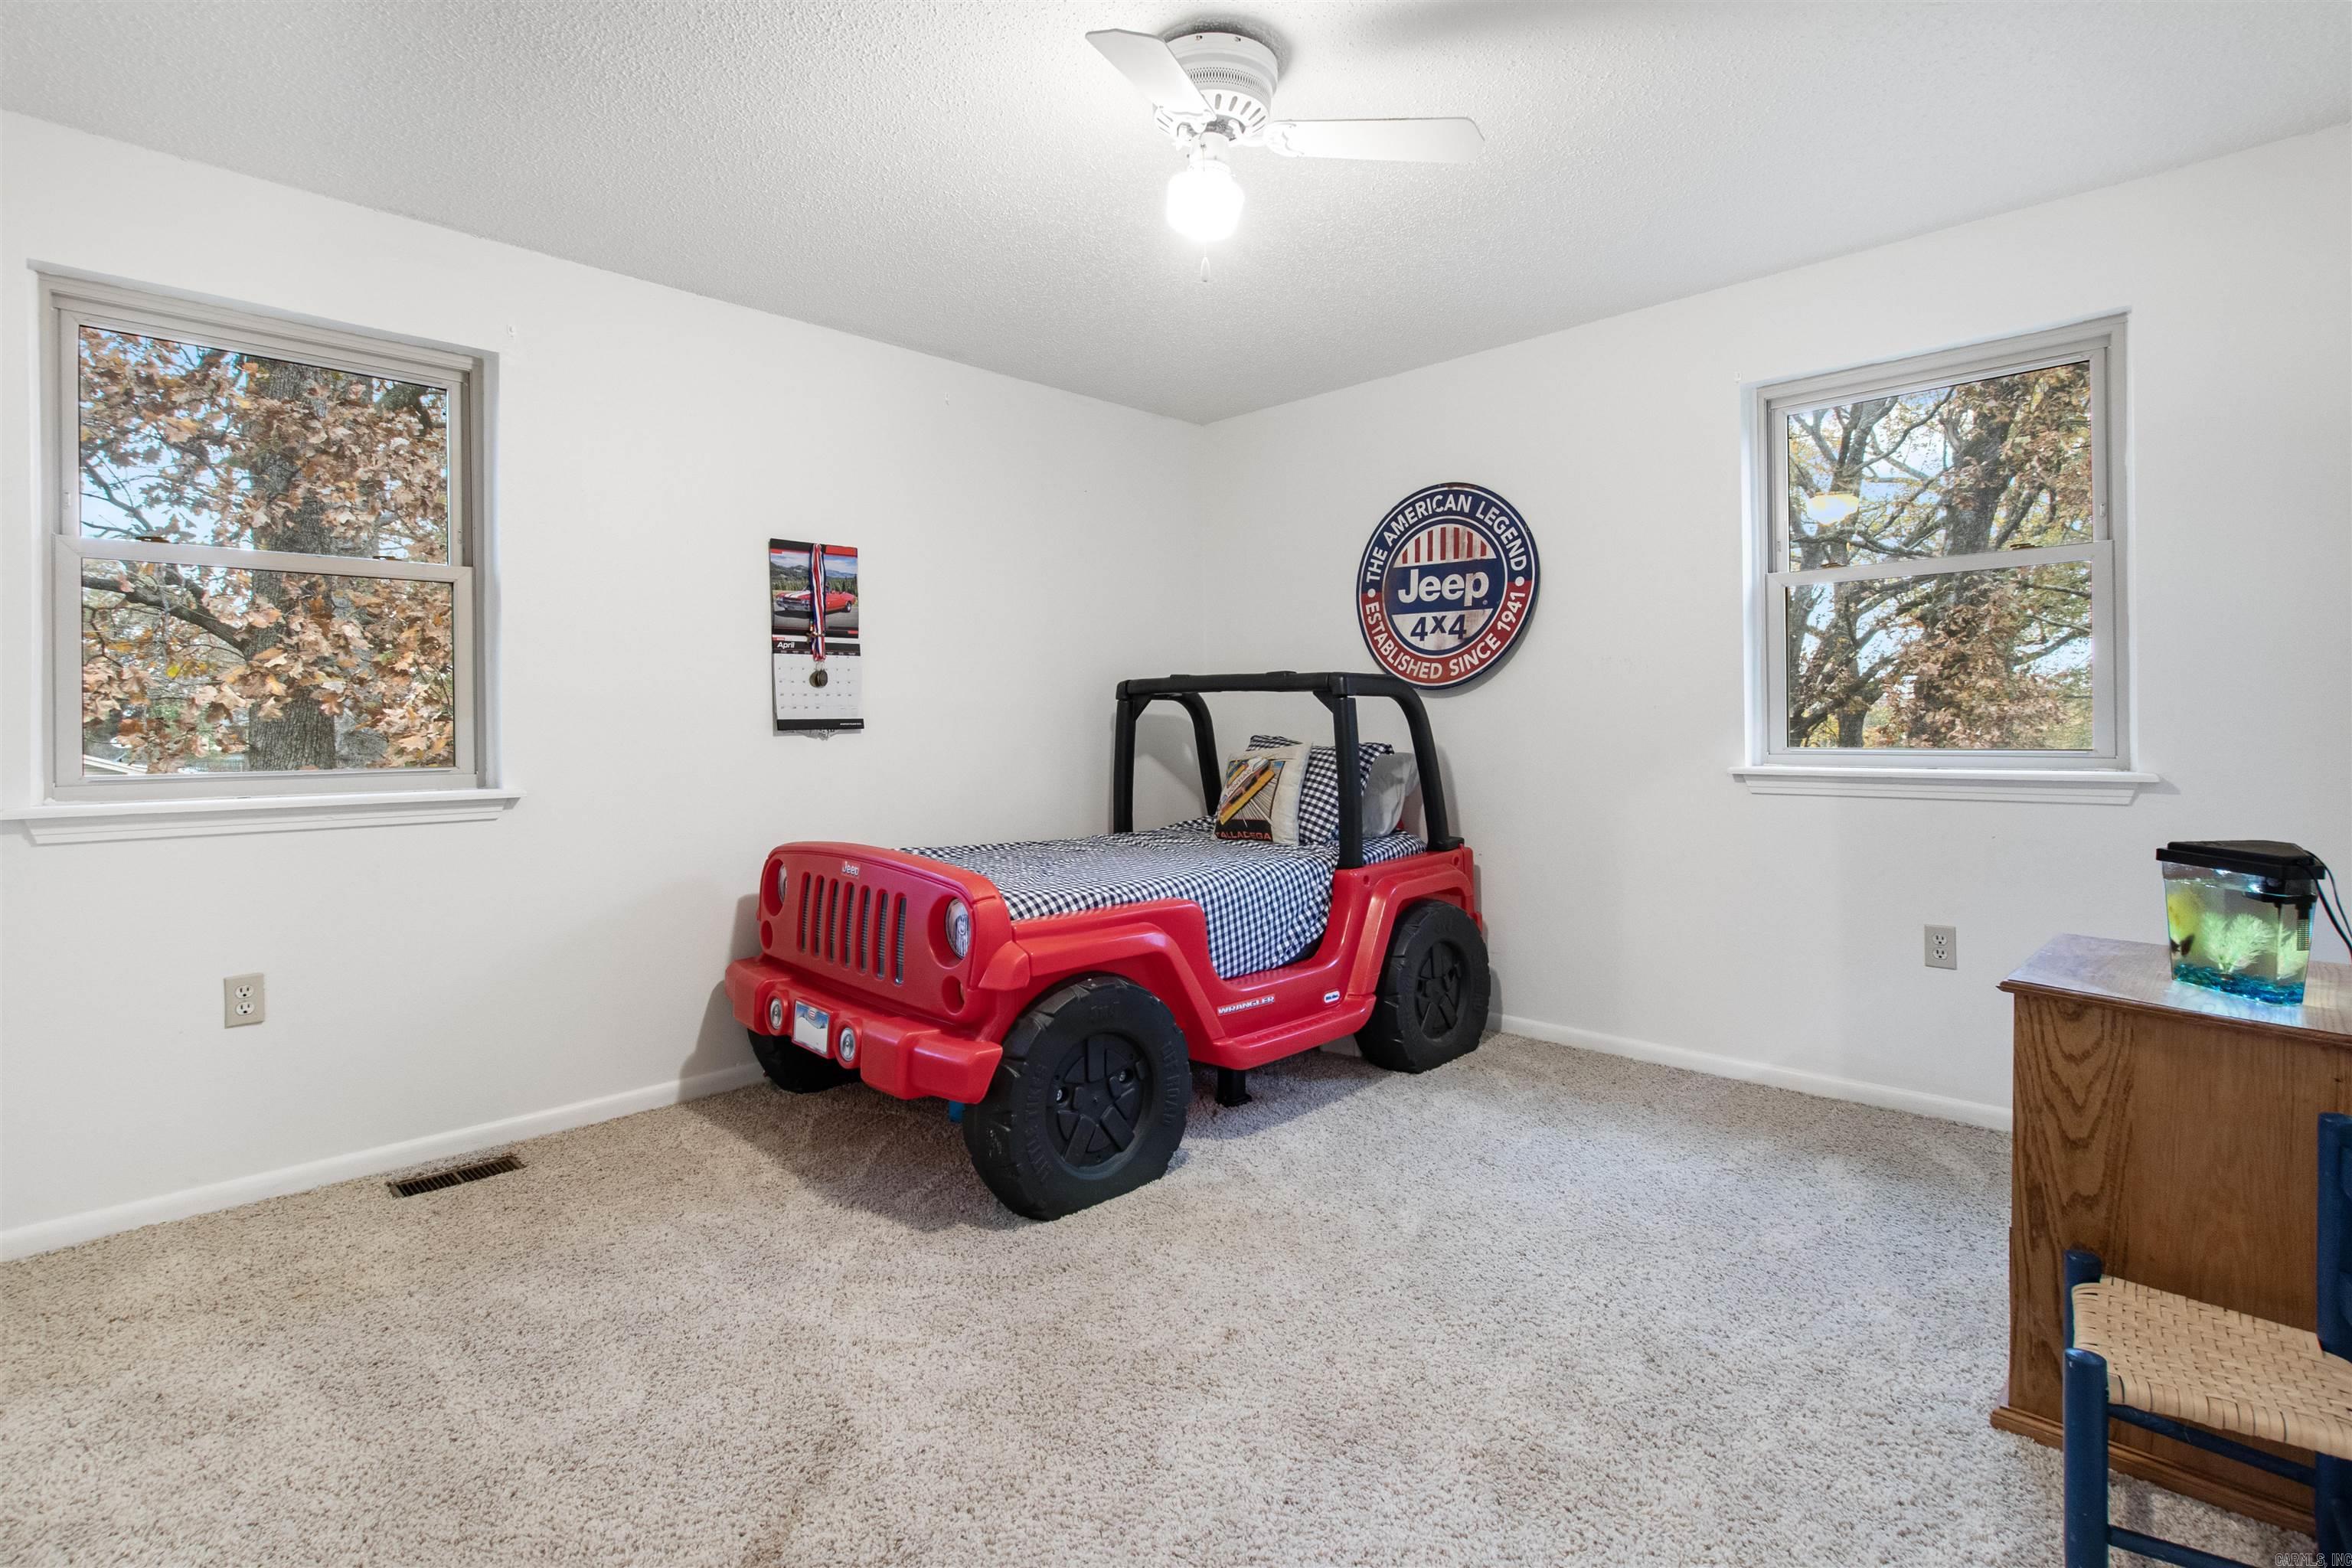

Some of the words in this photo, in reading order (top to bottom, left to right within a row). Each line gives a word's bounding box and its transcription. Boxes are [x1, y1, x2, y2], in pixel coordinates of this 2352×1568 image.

[1366, 546, 1388, 583] THE
[1383, 494, 1472, 547] AMERICAN
[1475, 501, 1527, 571] LEGEND
[1397, 569, 1489, 607] Jeep
[1365, 603, 1442, 679] ESTABLISHED
[1449, 633, 1501, 676] SINCE
[1498, 591, 1526, 632] 1941
[841, 861, 859, 877] Jeep
[1217, 996, 1275, 1014] WRANGLER
